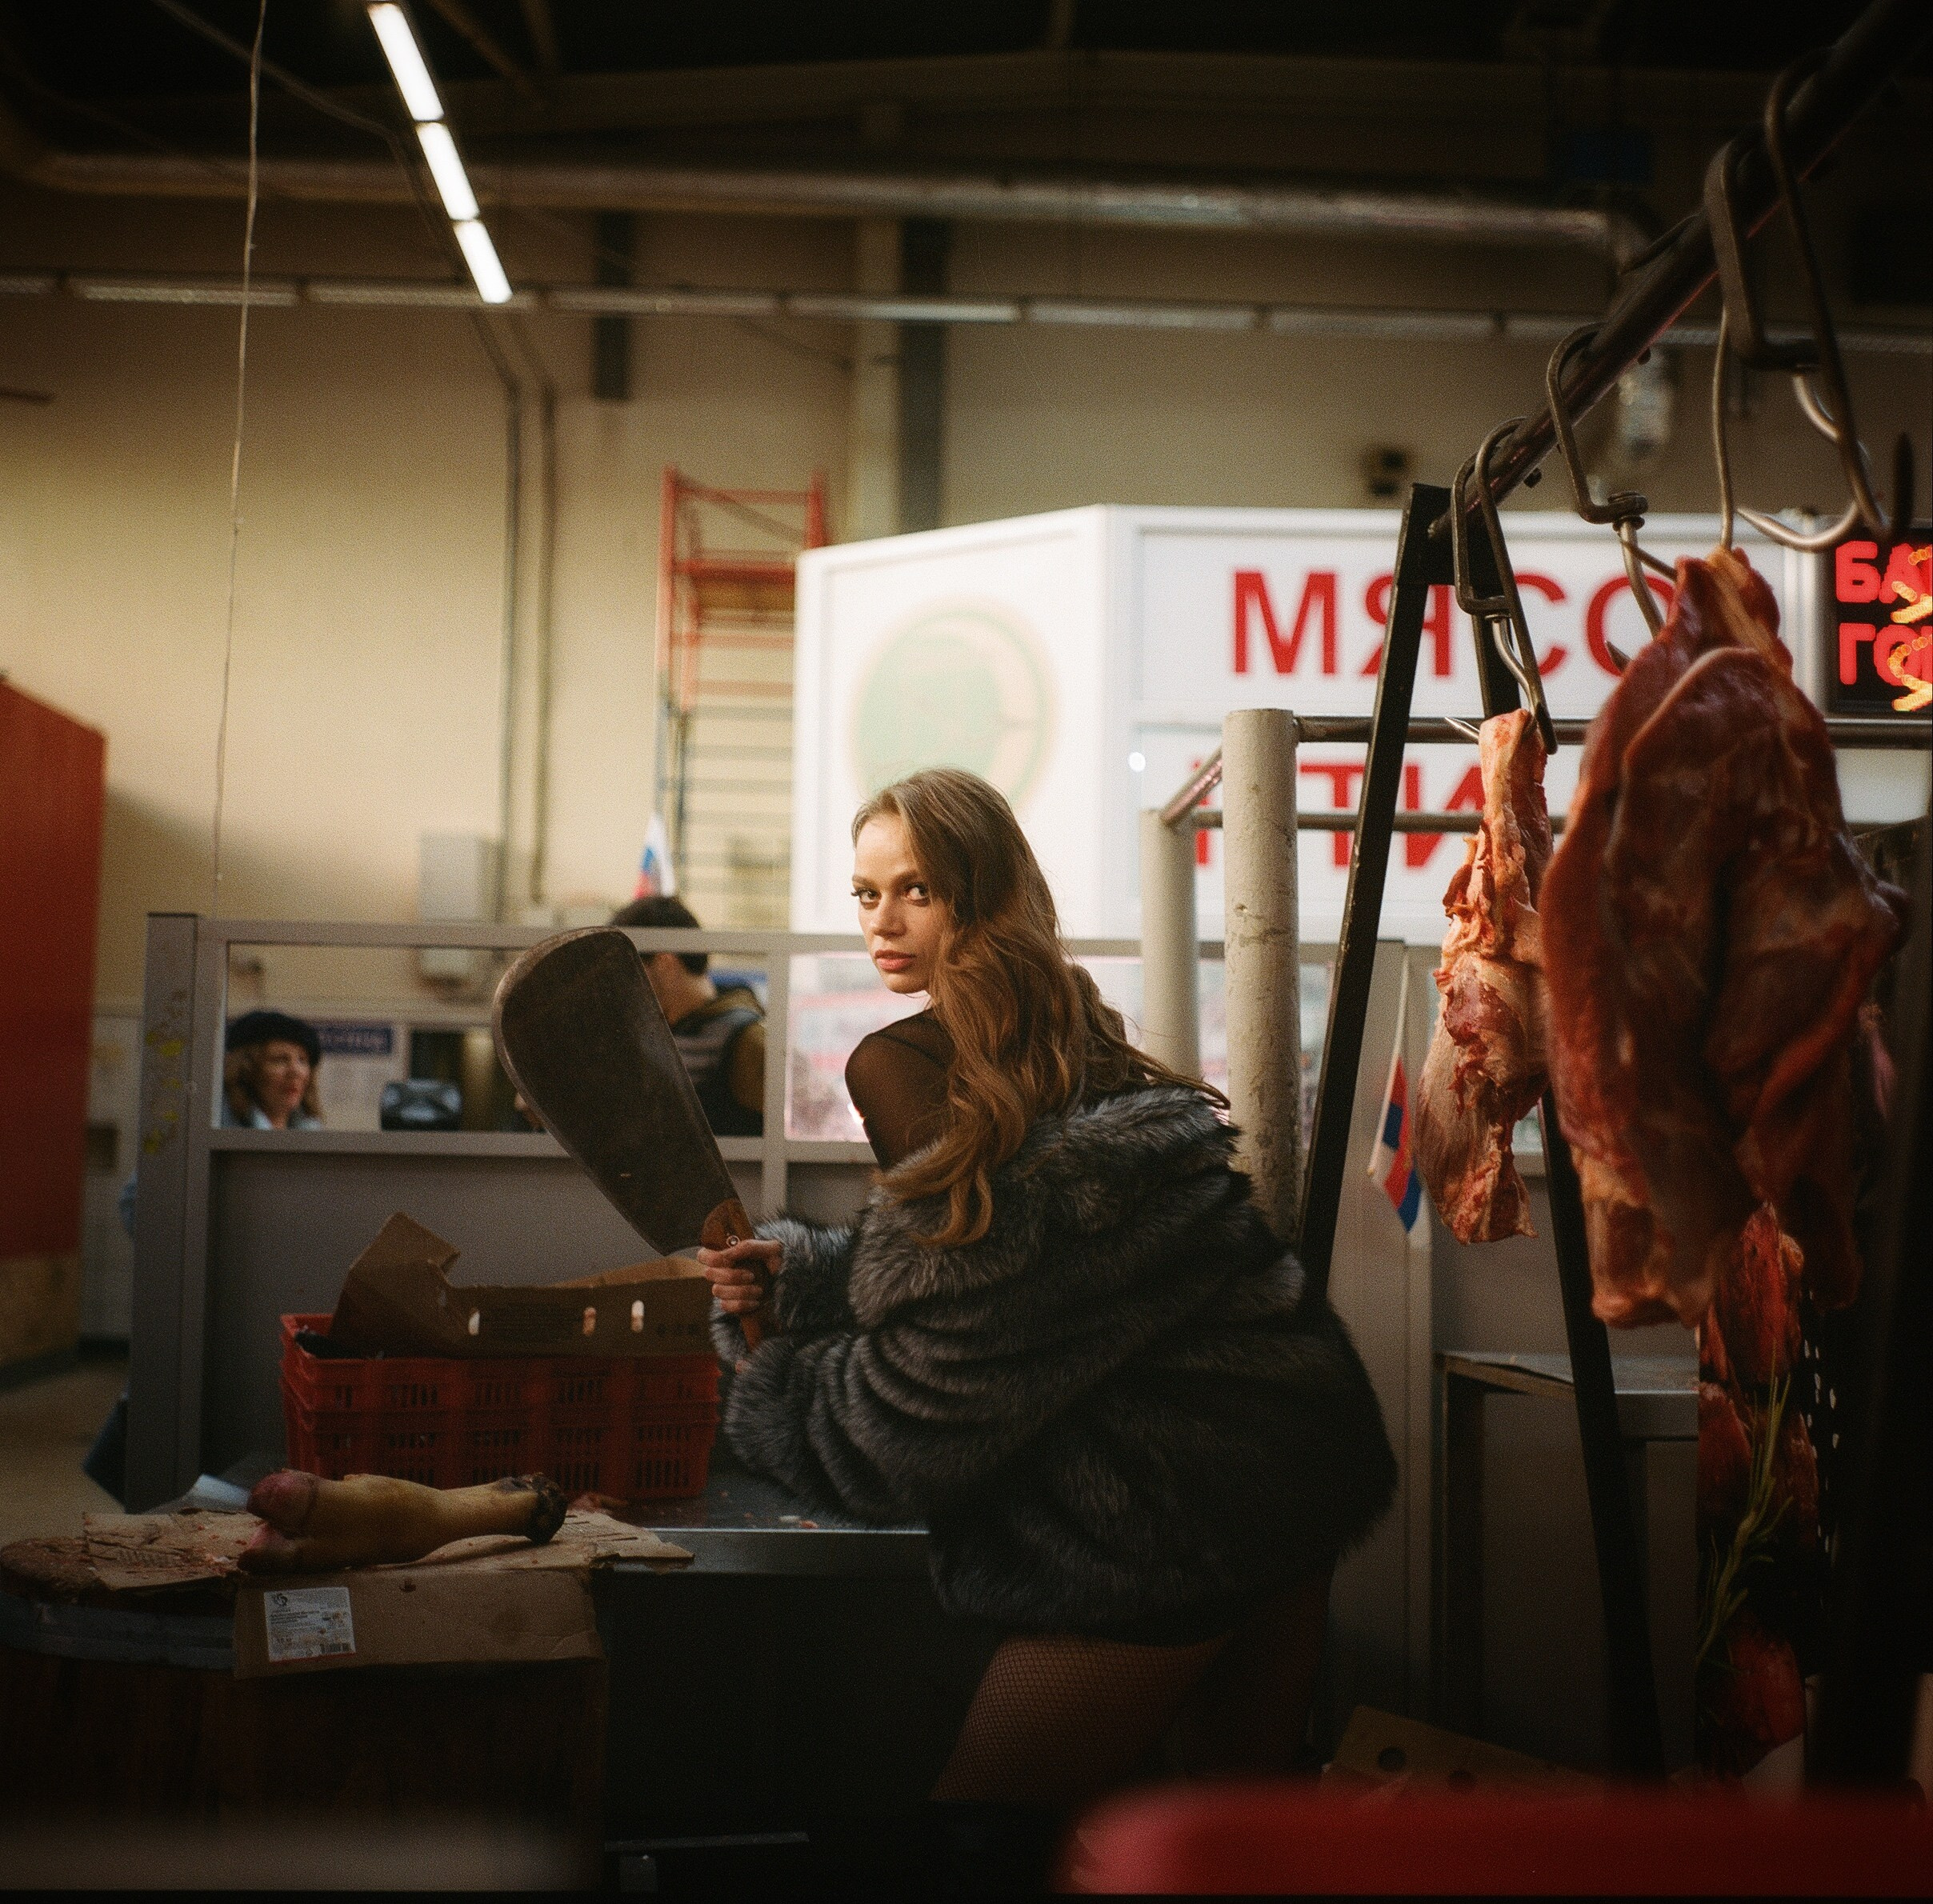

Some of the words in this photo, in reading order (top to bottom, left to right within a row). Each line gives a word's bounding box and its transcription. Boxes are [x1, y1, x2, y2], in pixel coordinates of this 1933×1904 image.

[1835, 541, 1932, 604] БА
[1233, 570, 1677, 678] МЯСО
[1839, 622, 1932, 686] ГО
